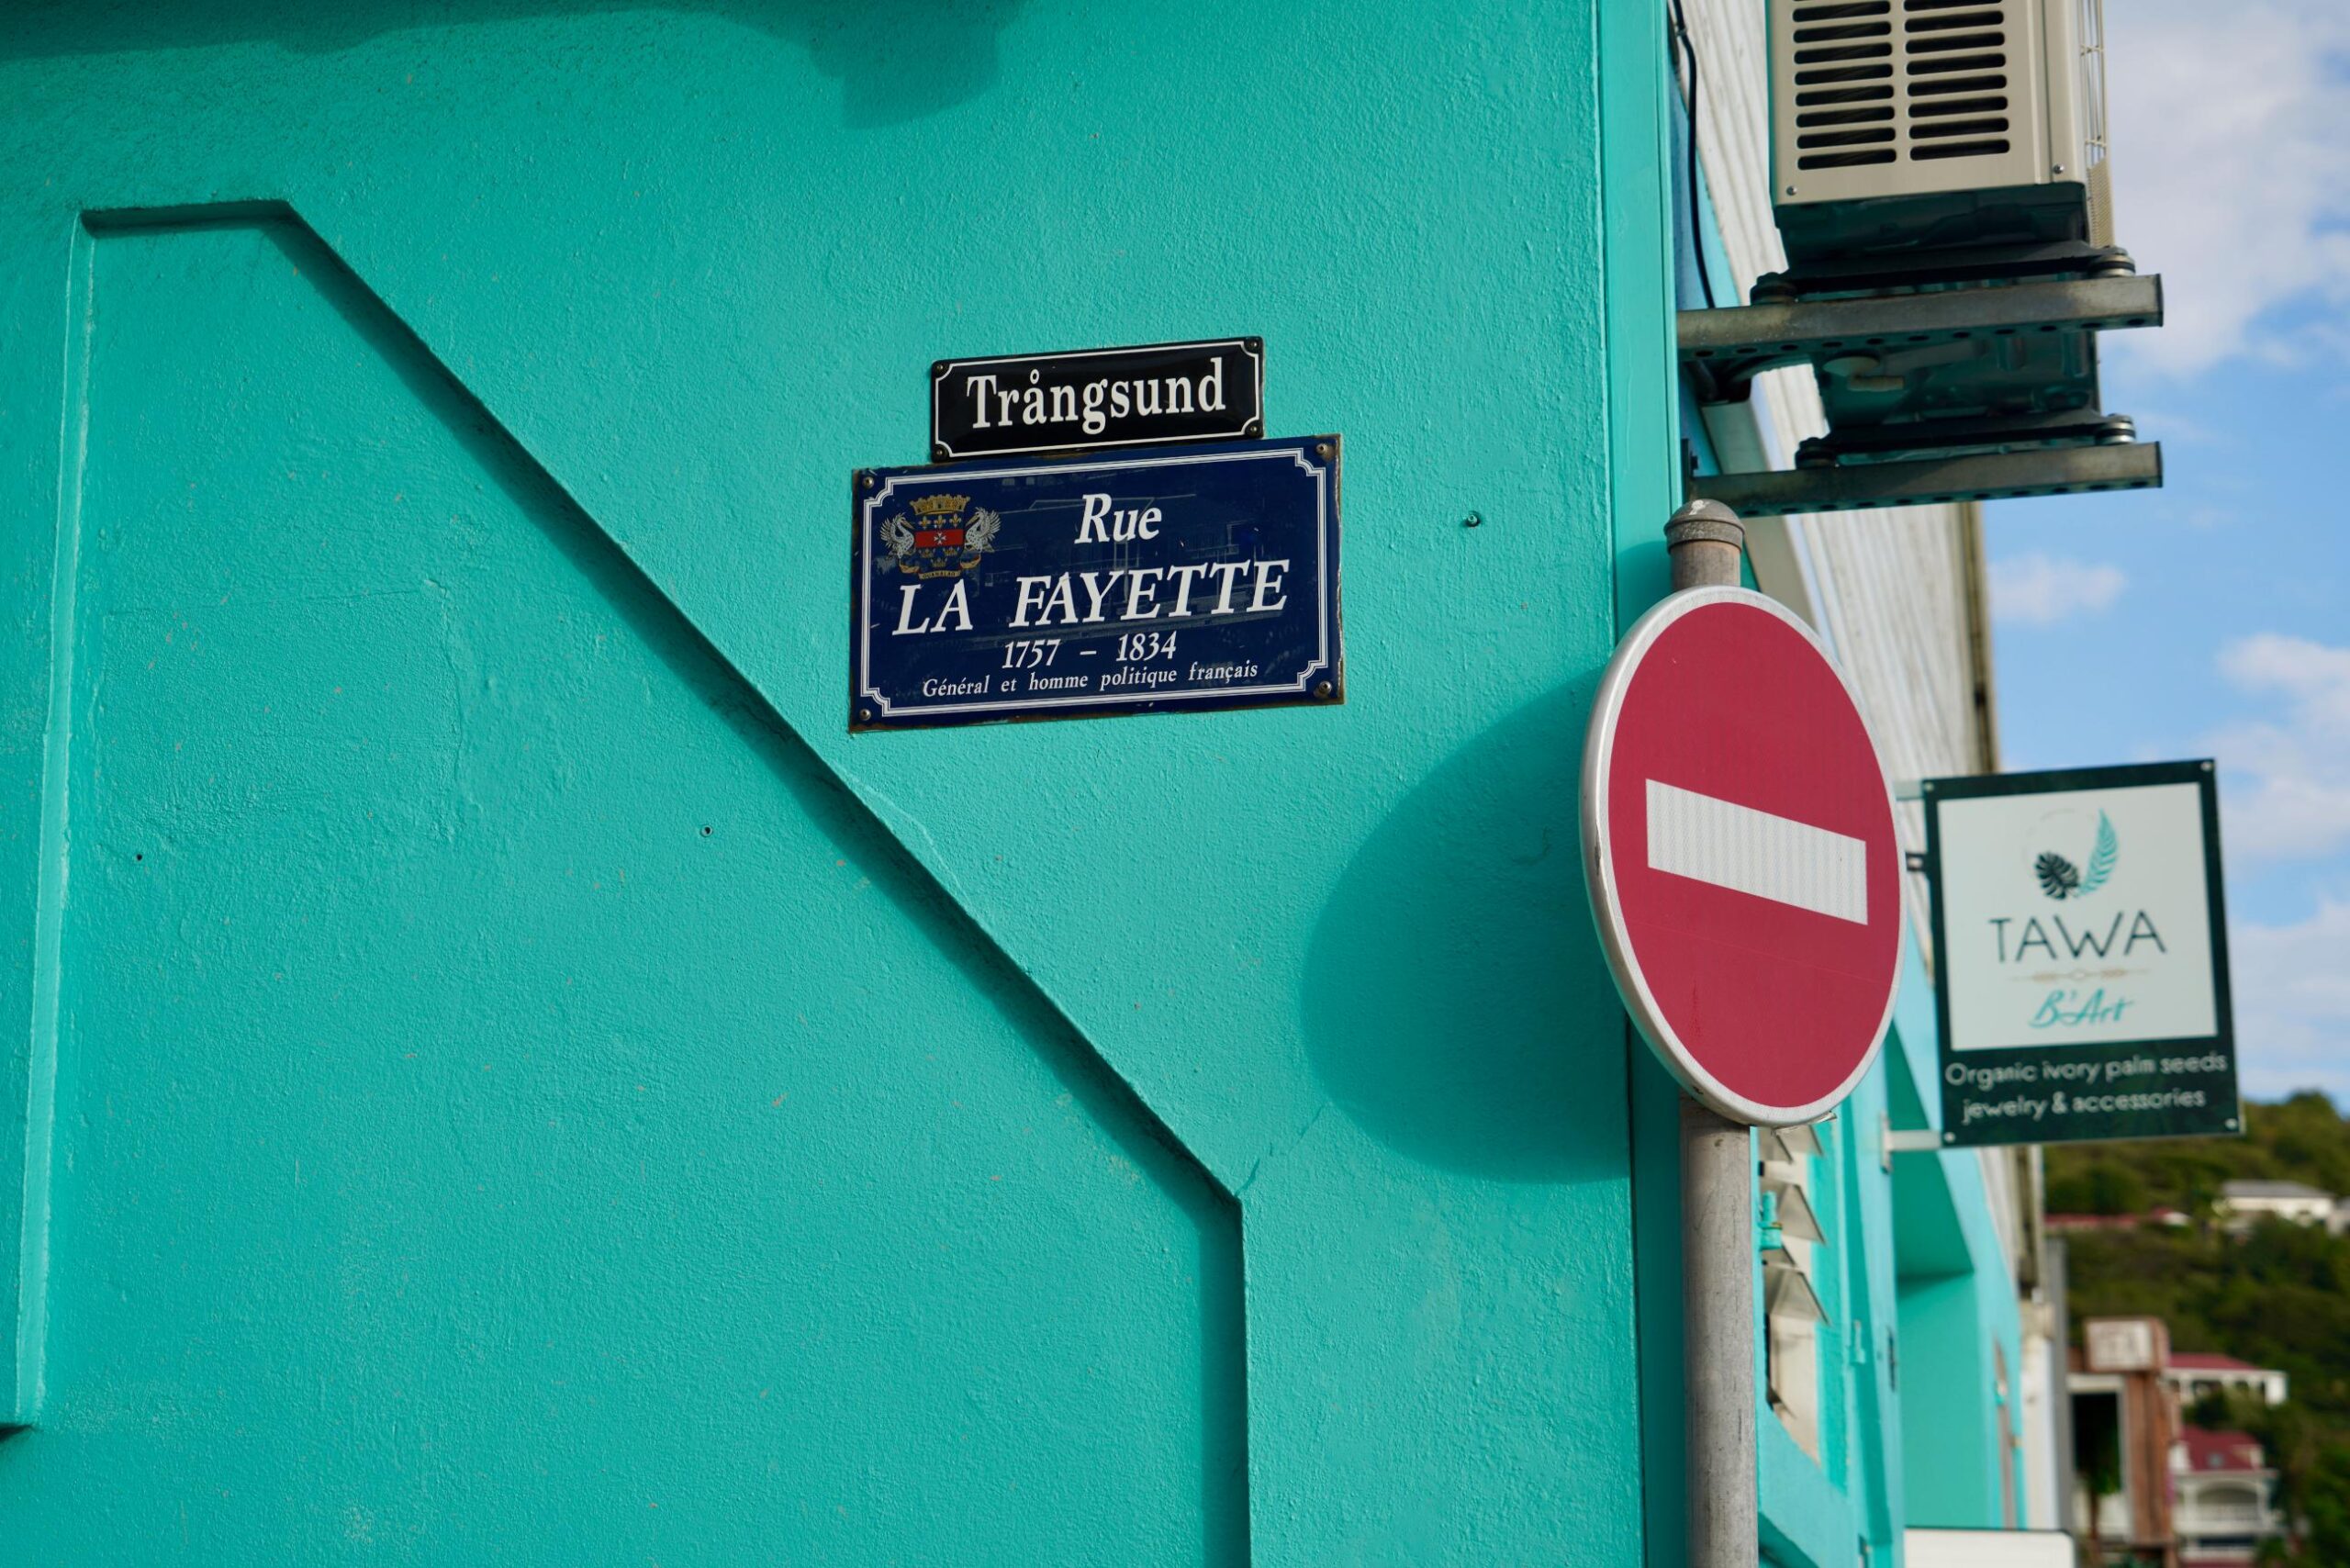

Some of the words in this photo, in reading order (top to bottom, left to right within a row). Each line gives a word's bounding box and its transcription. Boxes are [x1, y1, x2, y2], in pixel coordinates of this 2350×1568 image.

[967, 357, 1226, 434] Trångsund
[1074, 493, 1162, 544] Rue
[891, 577, 974, 636] LA
[1008, 558, 1291, 629] FAYETTE
[1002, 638, 1061, 669] 1757
[1115, 631, 1178, 662] 1834
[922, 675, 990, 698] Général
[1001, 678, 1017, 692] et
[1029, 673, 1089, 690] homme
[1100, 666, 1178, 691] politique
[1188, 659, 1259, 683] français
[1988, 909, 2167, 963] TAWA
[1945, 1061, 2038, 1092] Organic
[2042, 1059, 2101, 1084] ivory
[2105, 1054, 2156, 1082] palm
[2160, 1051, 2228, 1074] seeds
[1961, 1095, 2048, 1126] jewelry
[2052, 1091, 2068, 1114] &
[2072, 1087, 2207, 1114] accessories
